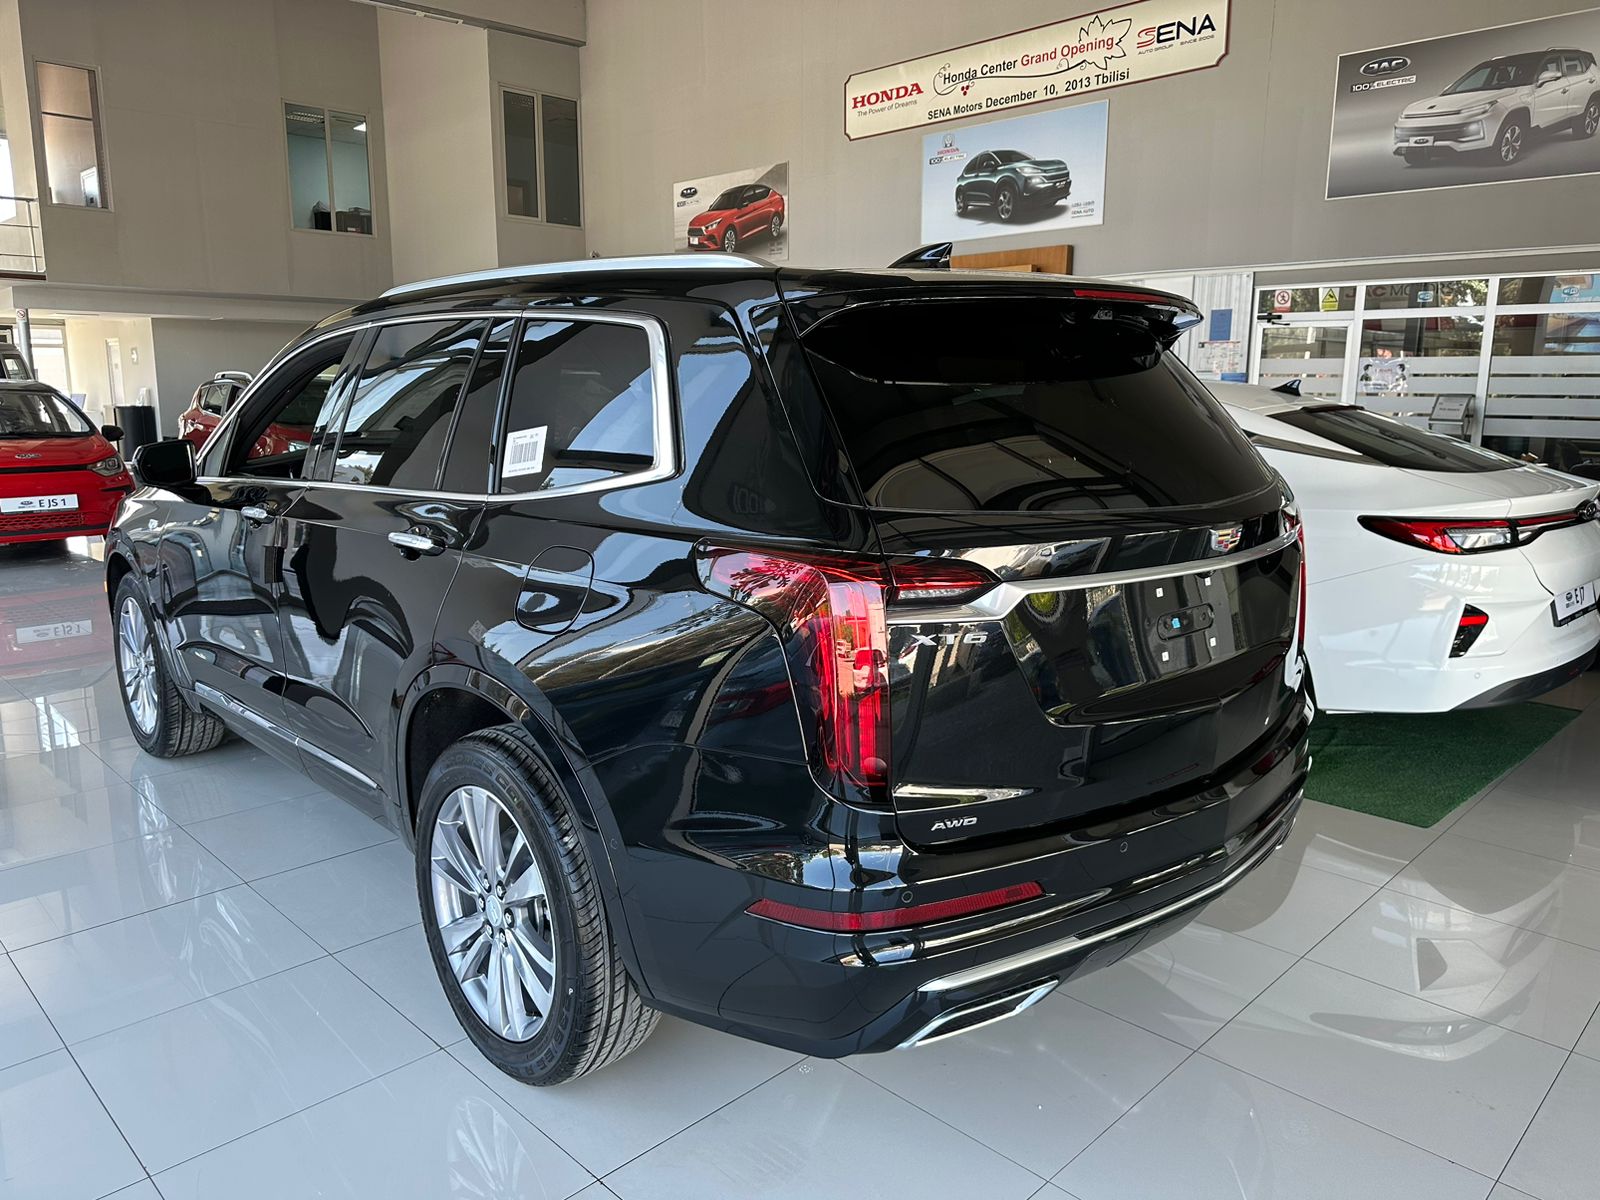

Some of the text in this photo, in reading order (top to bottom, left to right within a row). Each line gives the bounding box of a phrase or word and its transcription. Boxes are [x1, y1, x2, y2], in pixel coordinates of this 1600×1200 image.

[1137, 14, 1216, 48] SENA
[943, 37, 1114, 84] Honda Center Grand Opening
[852, 83, 923, 109] HONDA
[927, 68, 1130, 120] SENA Motors December 10, 2013 Tbilisi
[868, 106, 886, 116] Power
[887, 103, 894, 111] of
[895, 99, 917, 109] Dreams
[911, 632, 989, 646] XT6
[931, 817, 978, 831] AWD
